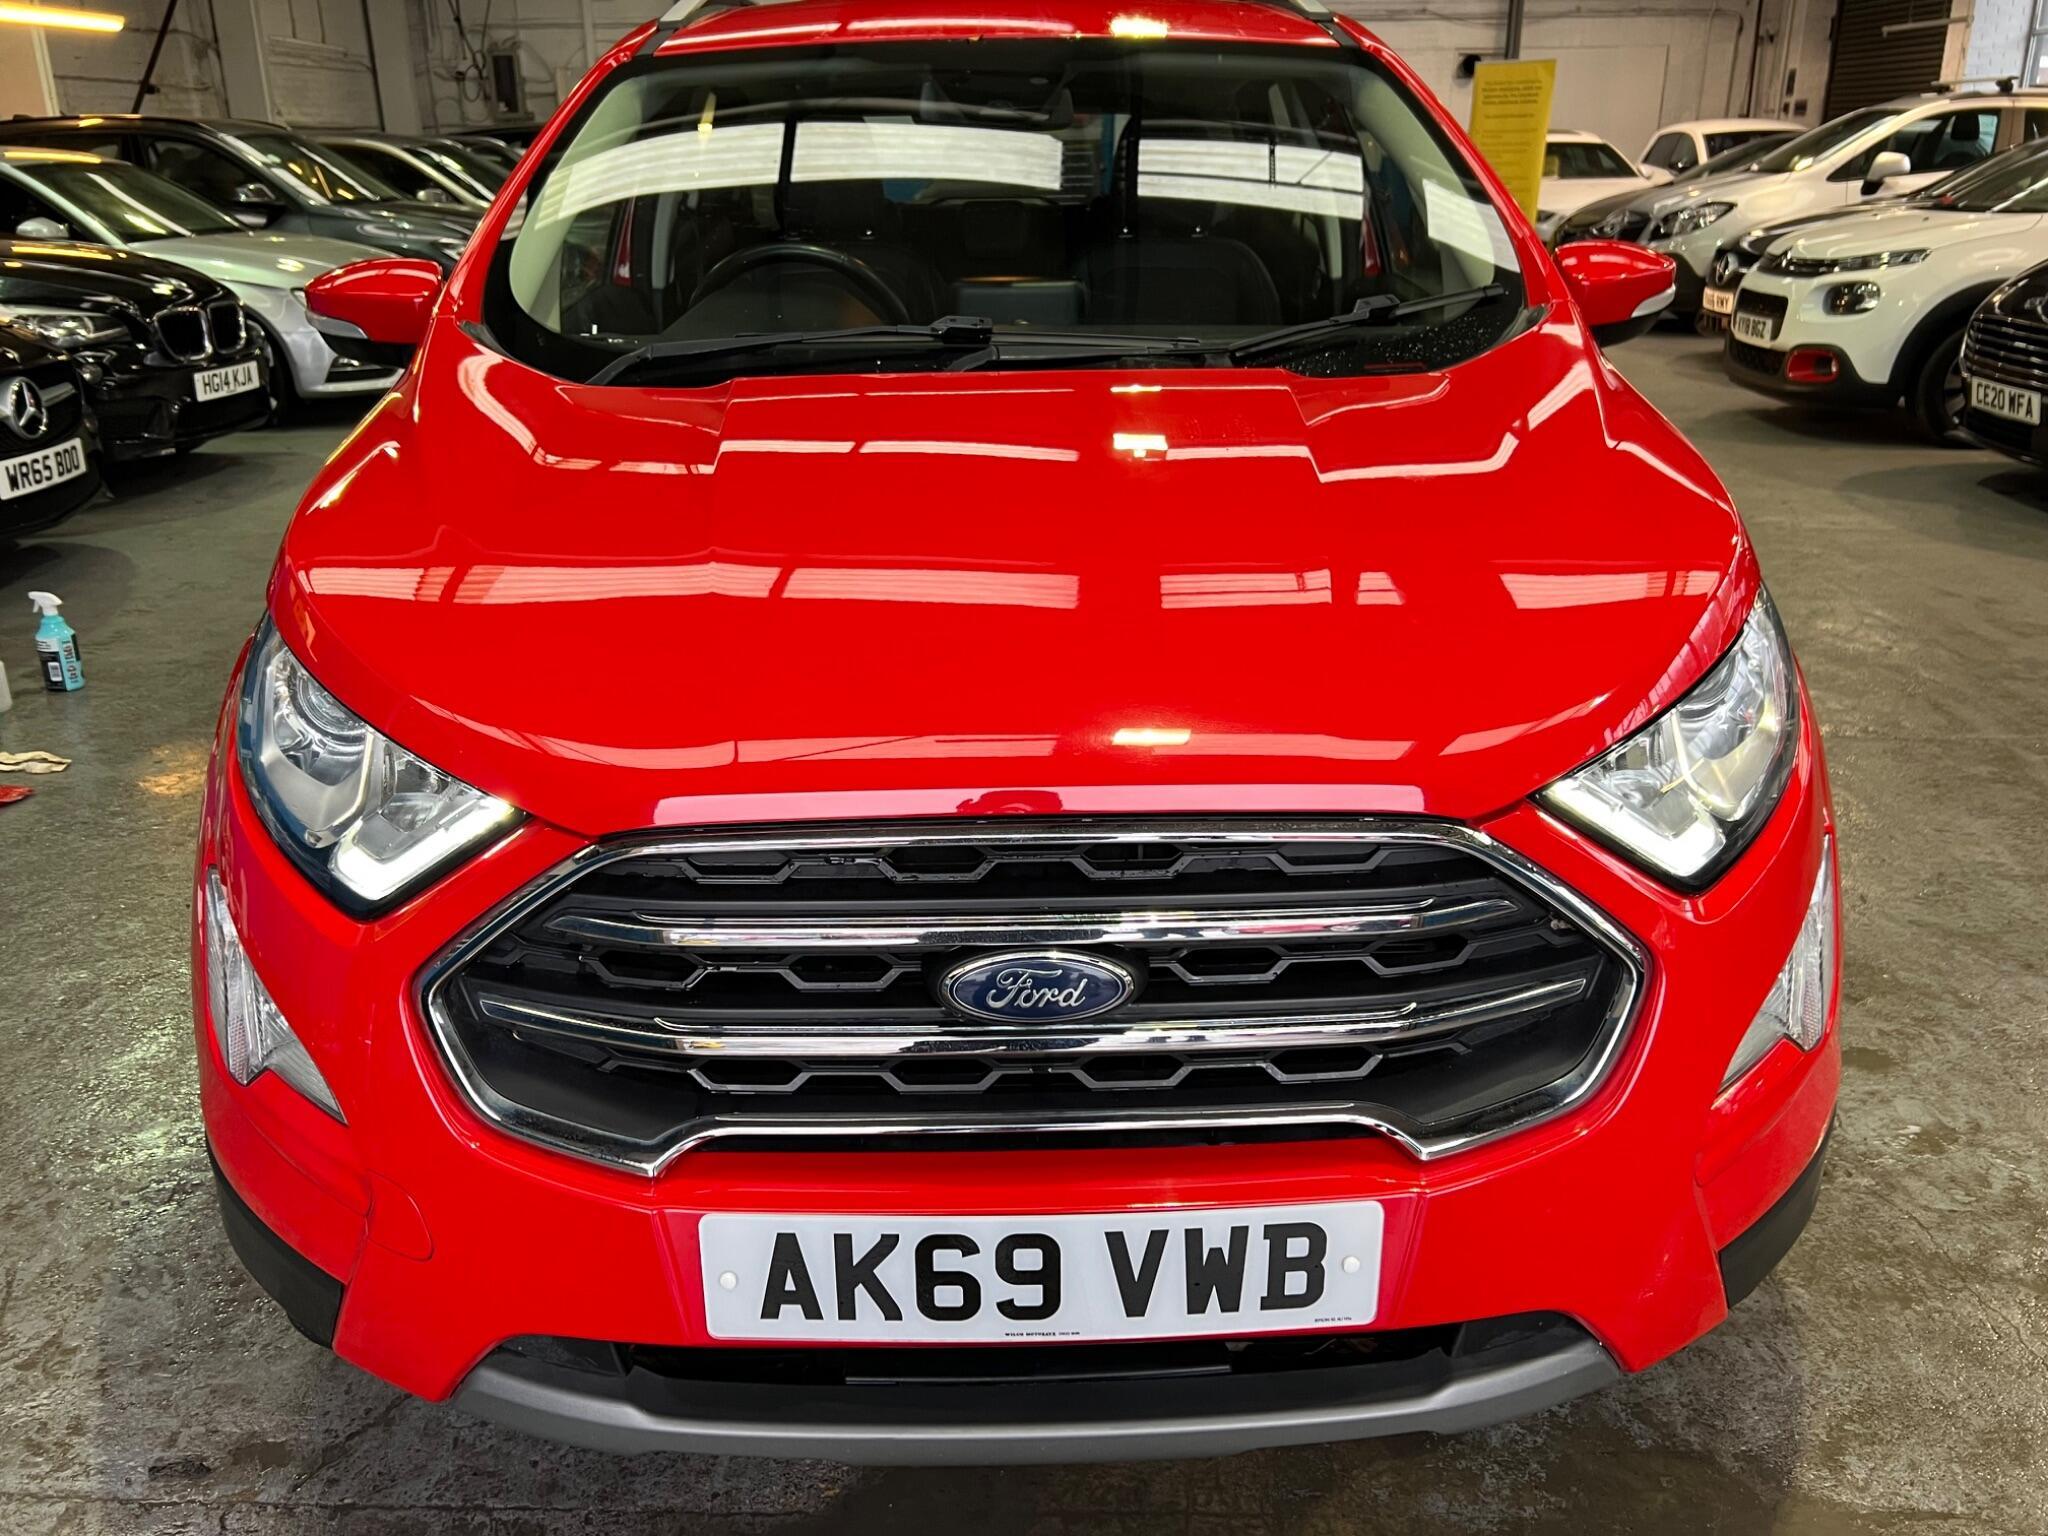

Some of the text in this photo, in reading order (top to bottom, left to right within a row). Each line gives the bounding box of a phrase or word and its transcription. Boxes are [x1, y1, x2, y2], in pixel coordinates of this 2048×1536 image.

[202, 365, 254, 396] HG14 KJA
[1976, 381, 2006, 412] CE20
[5, 454, 53, 492] WR65
[985, 967, 1089, 1009] Ford
[760, 1221, 1329, 1322] AK69 VWB
